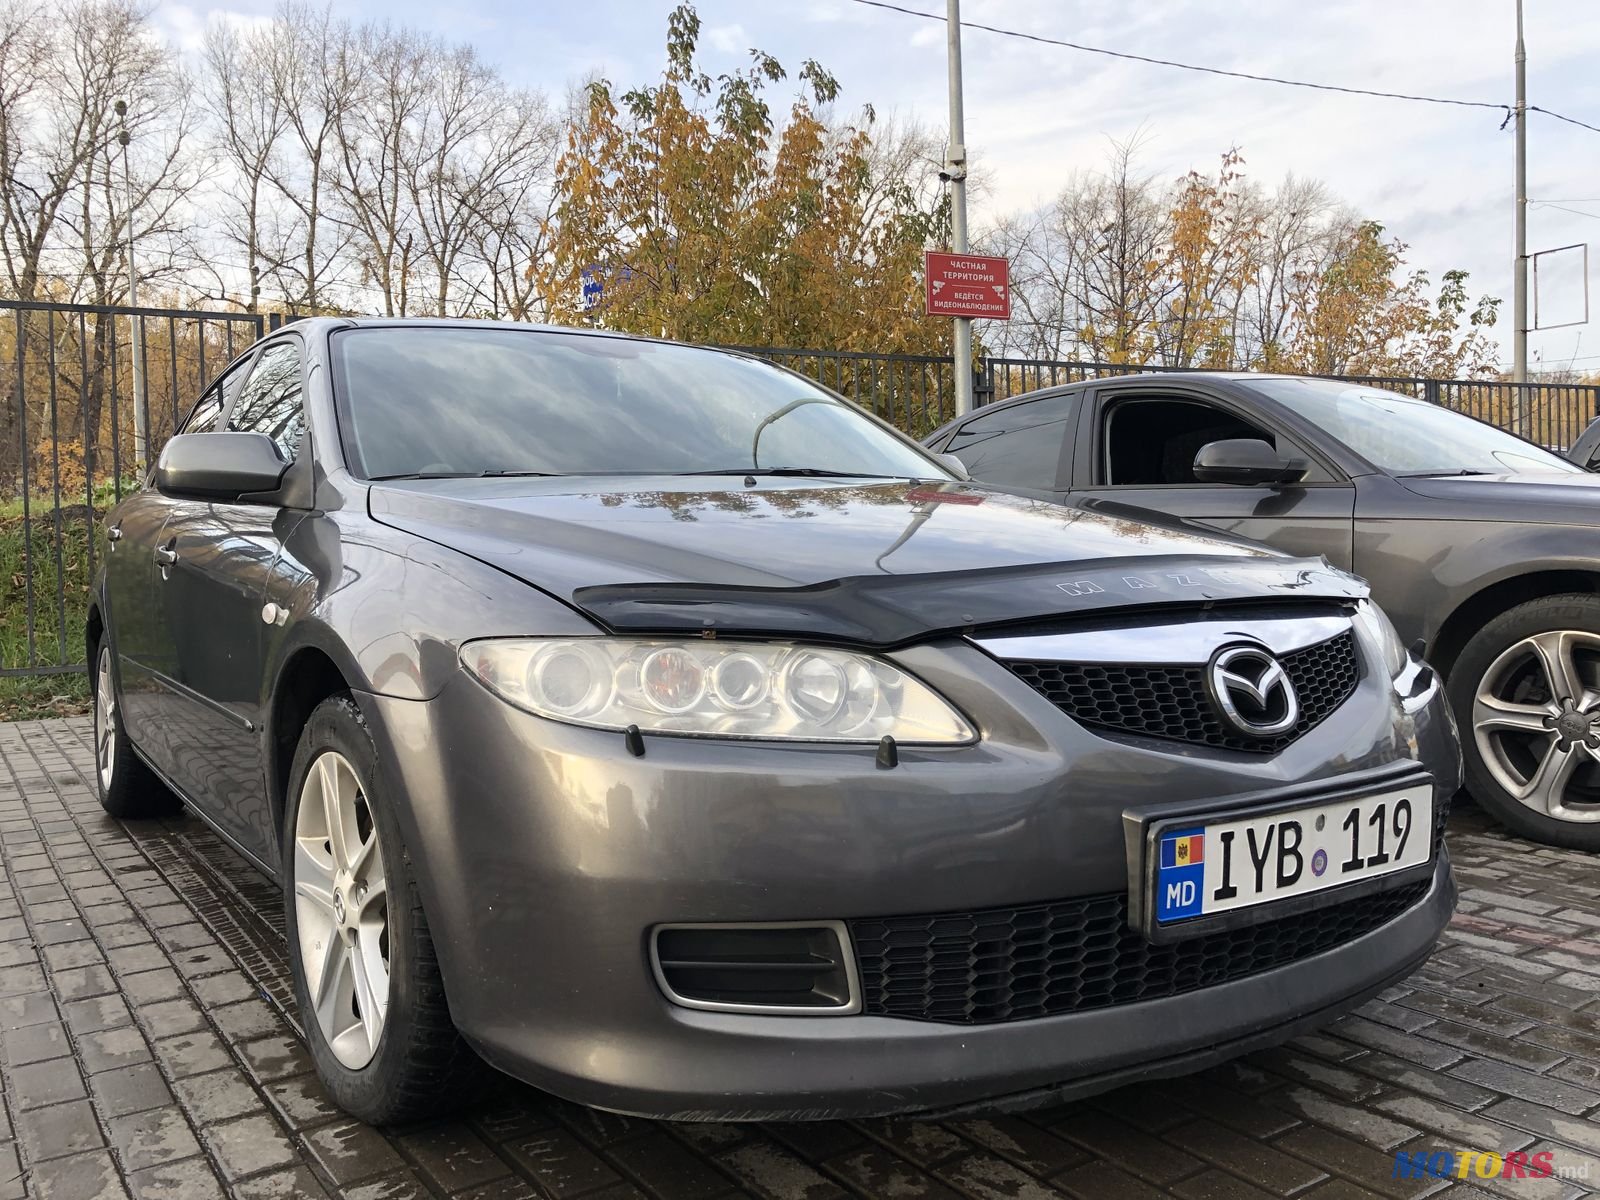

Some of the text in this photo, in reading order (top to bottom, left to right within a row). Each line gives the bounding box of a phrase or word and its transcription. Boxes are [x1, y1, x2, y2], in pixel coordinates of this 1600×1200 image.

[951, 260, 986, 270] ЧАСТНАЯ
[943, 271, 994, 282] ТЕРРИТОРИЯ
[934, 301, 1004, 311] ВИДЕОНАБЛЮДЕНИЕ
[1213, 798, 1412, 901] IYB 119
[1166, 881, 1195, 909] MD
